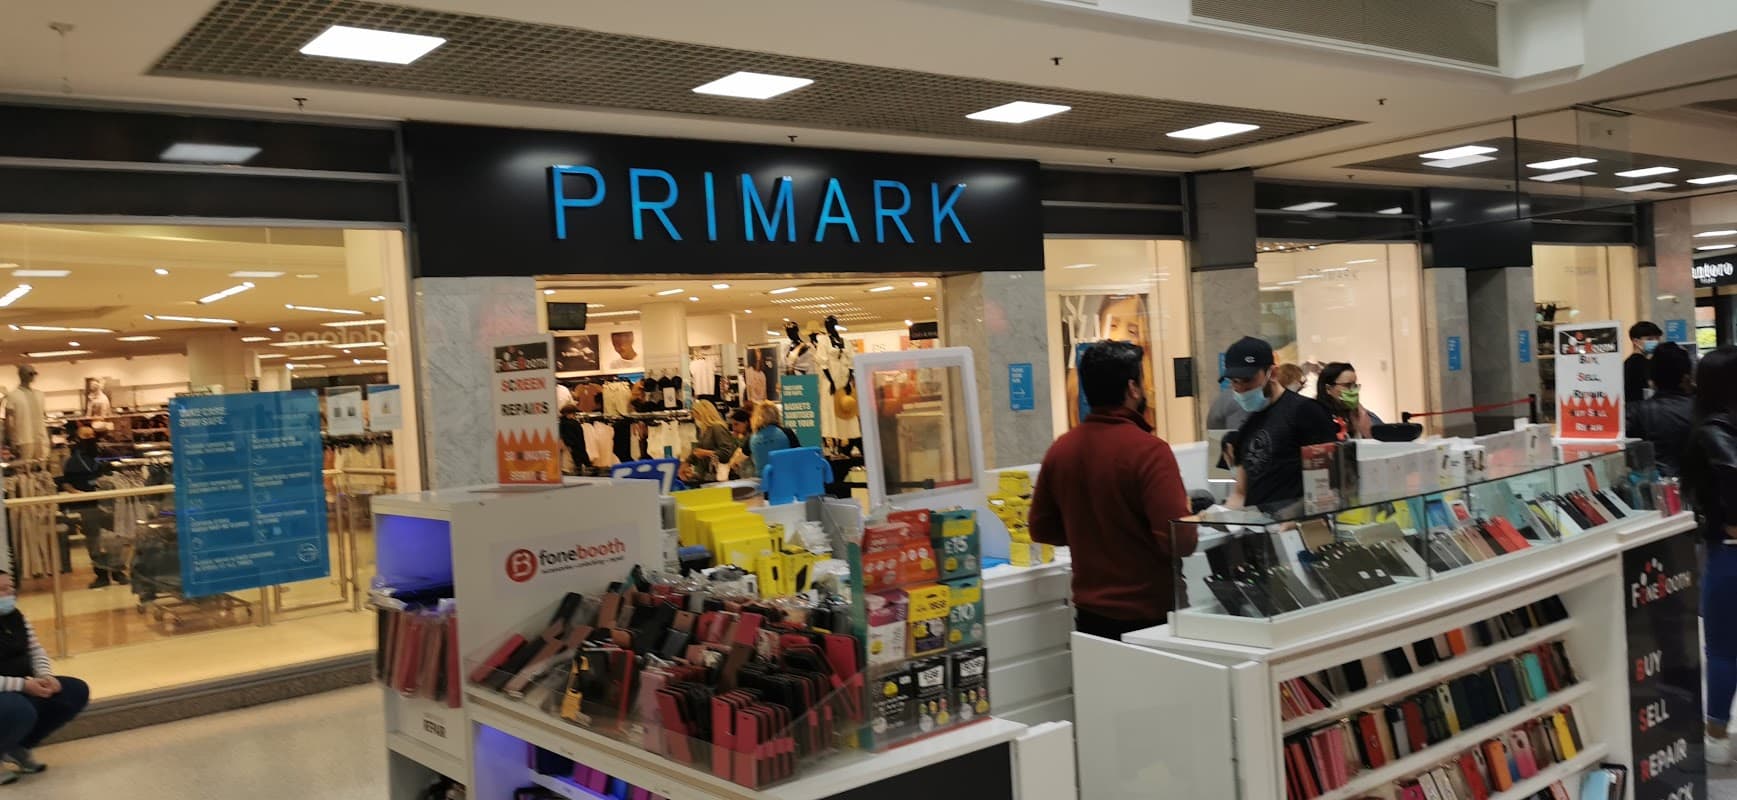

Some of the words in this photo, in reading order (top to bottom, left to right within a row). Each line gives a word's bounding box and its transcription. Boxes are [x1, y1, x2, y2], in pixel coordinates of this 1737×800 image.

[552, 163, 972, 244] PRIMARK
[501, 377, 546, 392] SCREEN
[501, 401, 549, 416] REPAIRS
[539, 537, 626, 565] fonebooth
[943, 535, 970, 554] £15
[949, 602, 977, 622] £10
[1635, 649, 1663, 682] BUY
[1638, 697, 1670, 732] SELL
[1640, 738, 1688, 782] REPAIR
